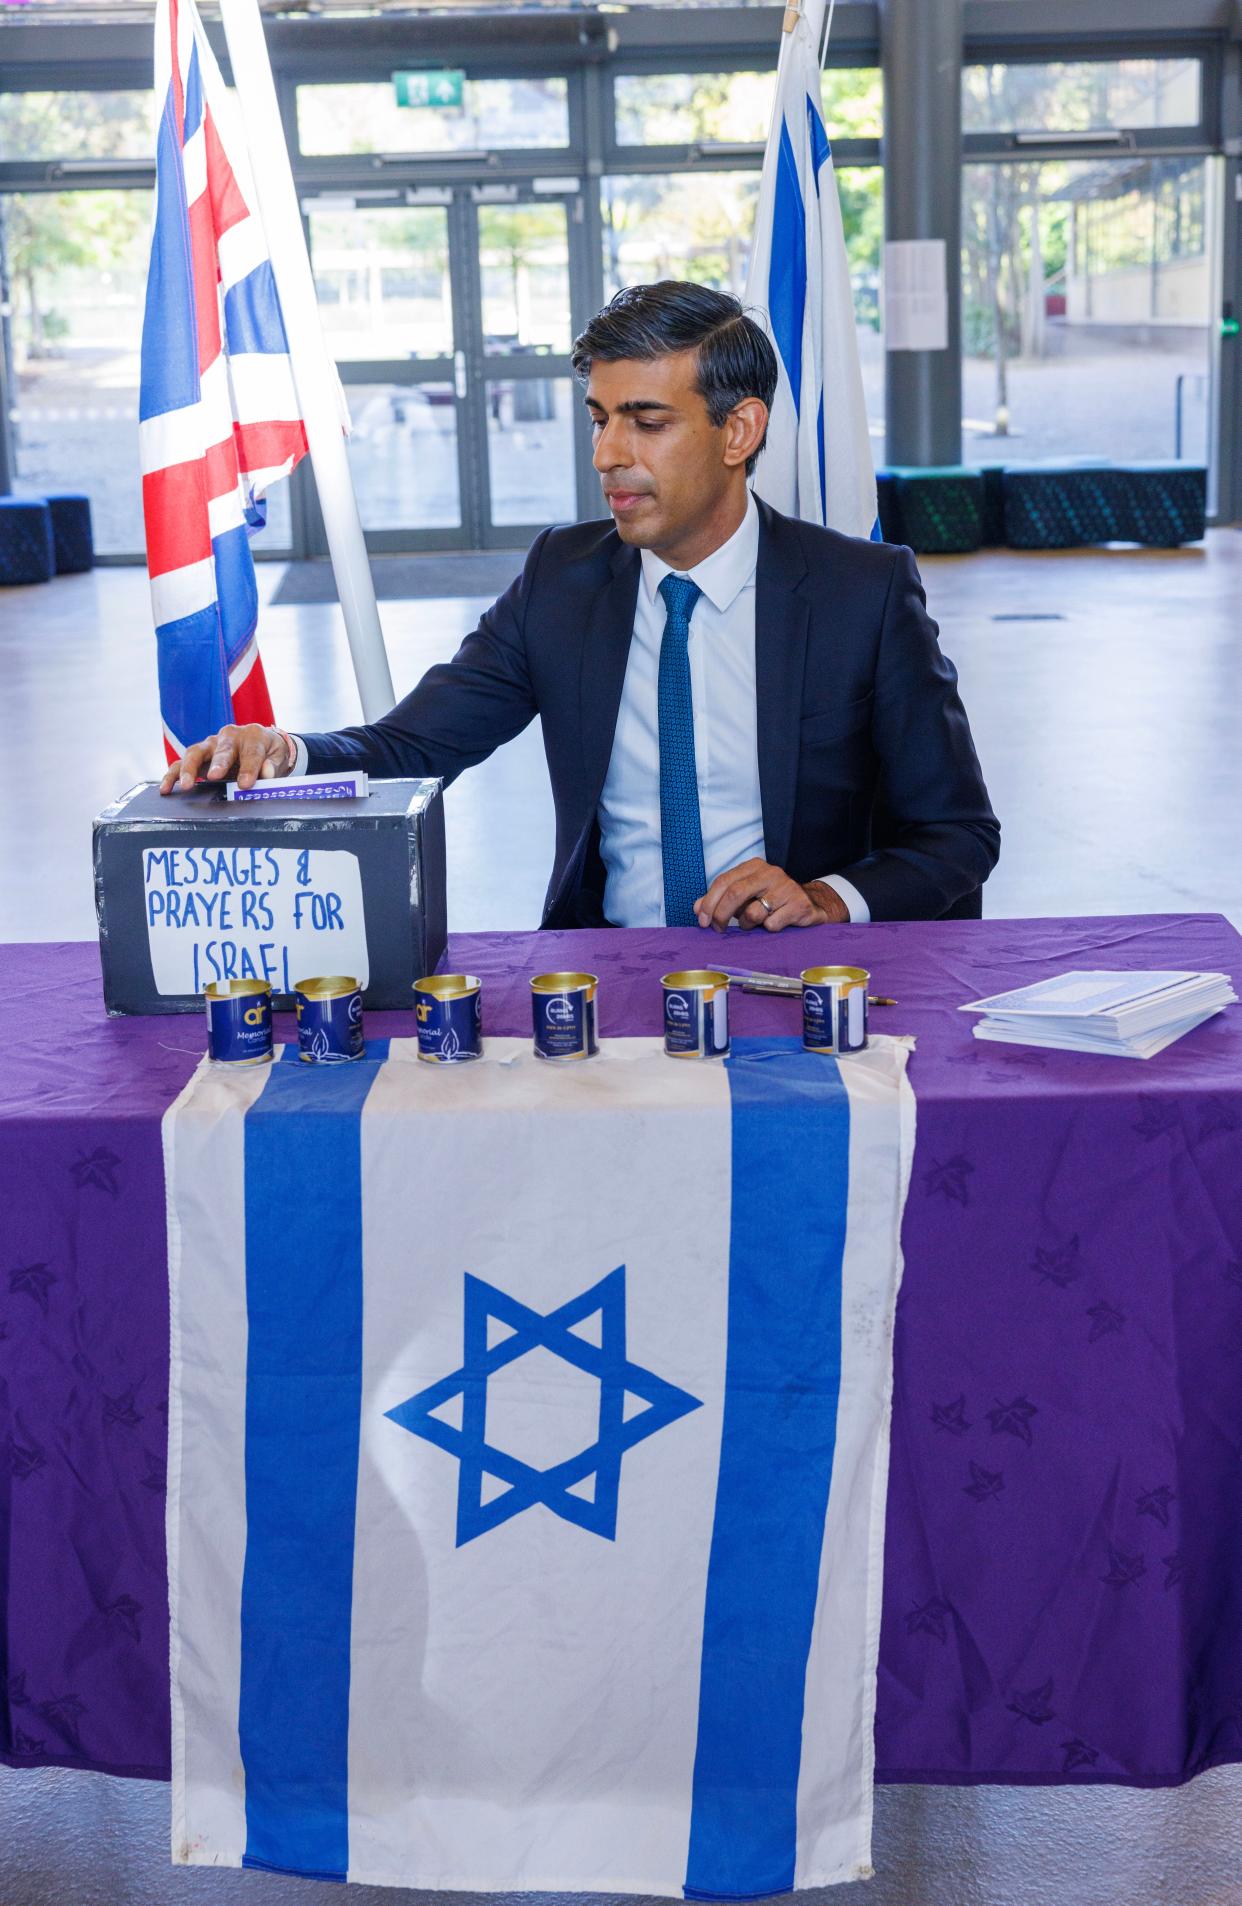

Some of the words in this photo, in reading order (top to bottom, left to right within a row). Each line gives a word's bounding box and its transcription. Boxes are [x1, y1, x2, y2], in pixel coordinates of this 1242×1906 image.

[146, 847, 280, 887] MESSAGES
[296, 849, 312, 886] &
[148, 889, 274, 931] PRAYERS
[293, 891, 344, 930] FOR
